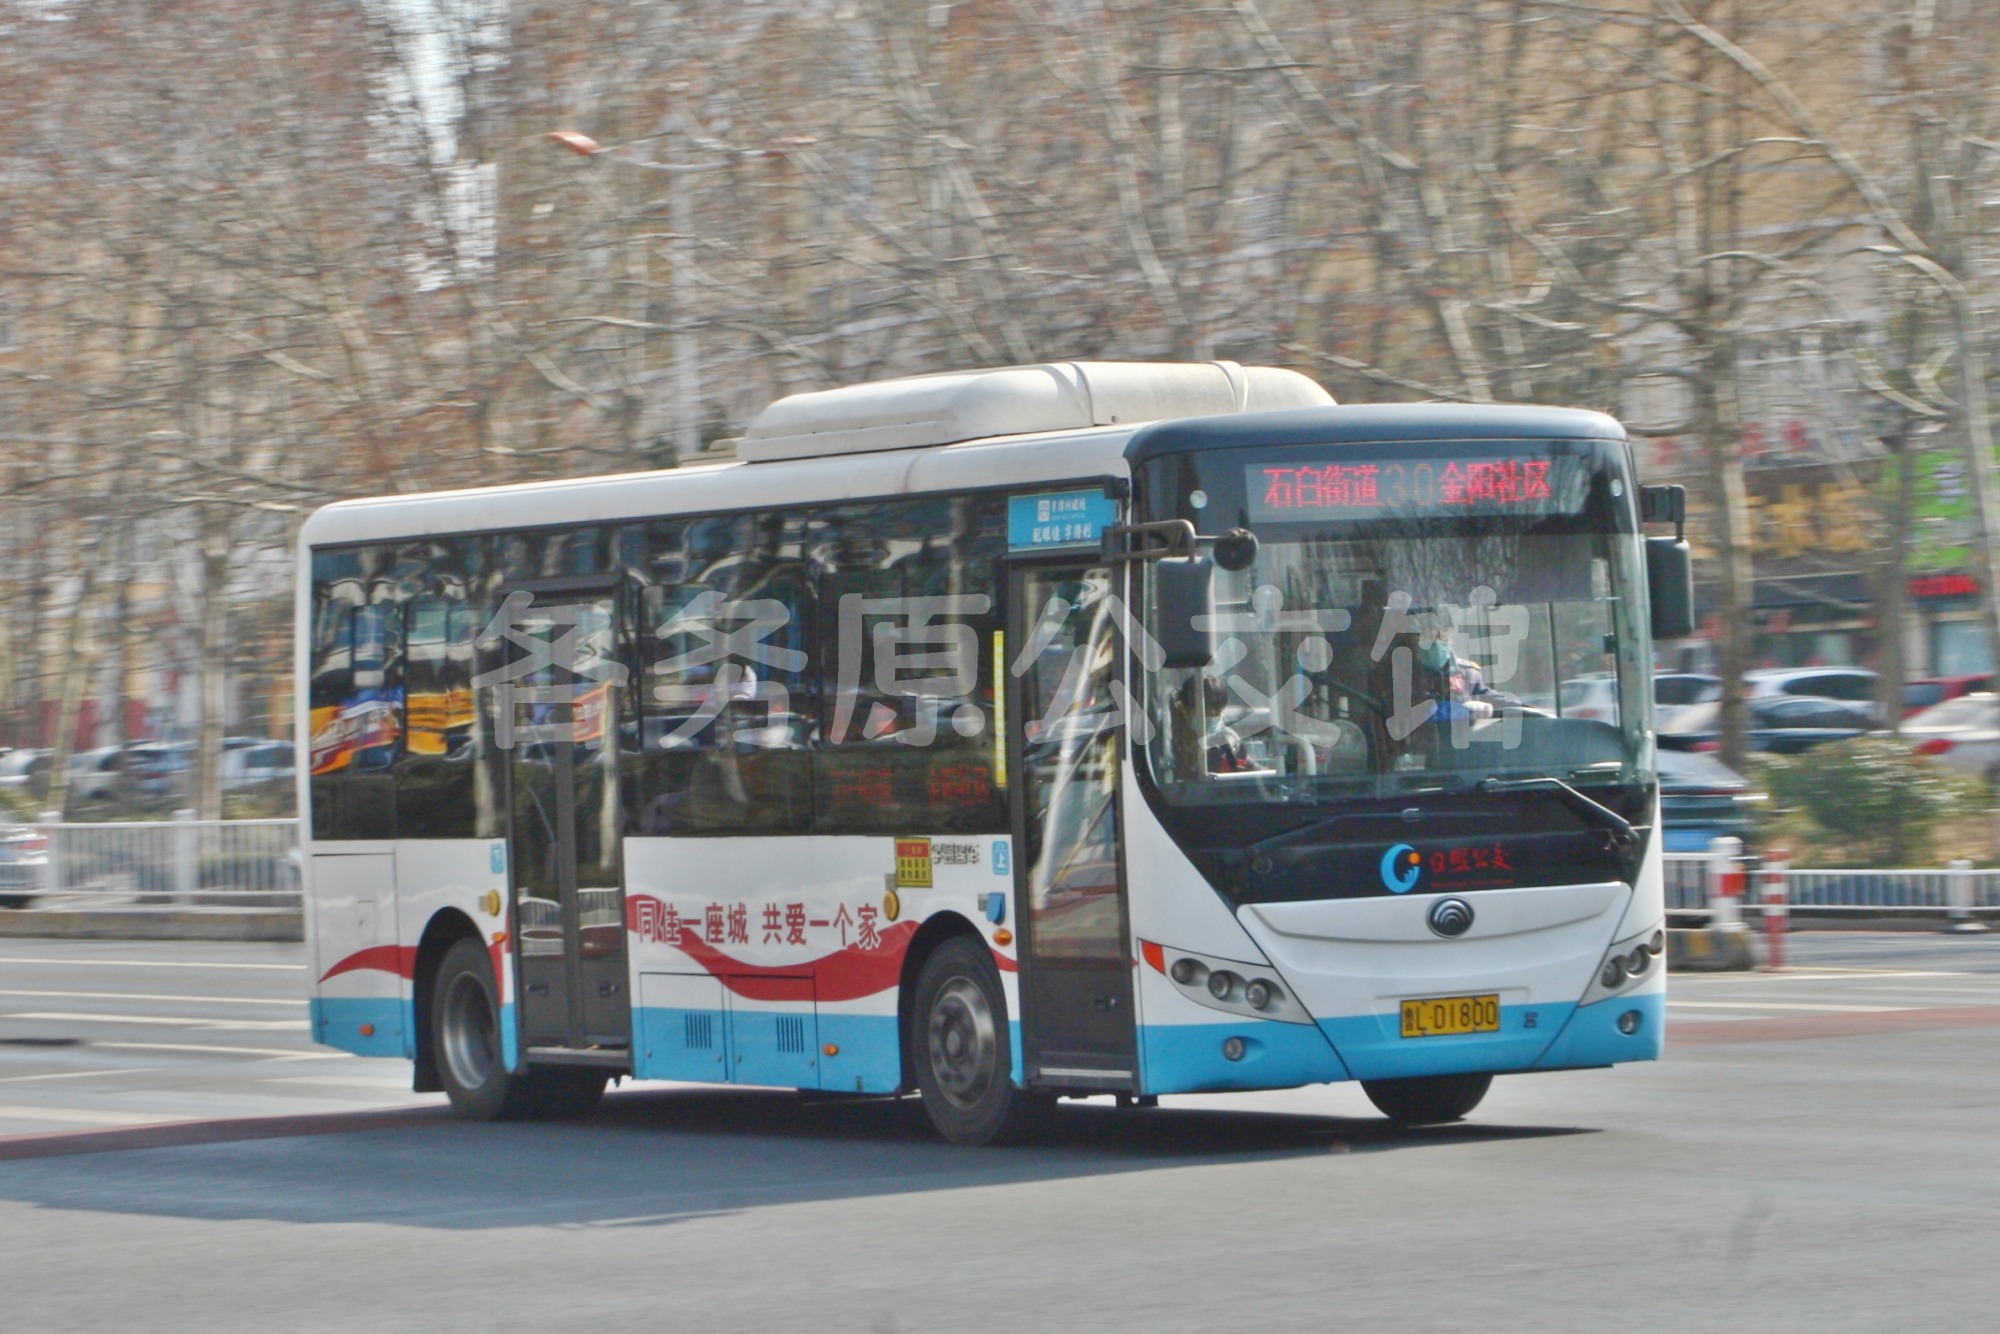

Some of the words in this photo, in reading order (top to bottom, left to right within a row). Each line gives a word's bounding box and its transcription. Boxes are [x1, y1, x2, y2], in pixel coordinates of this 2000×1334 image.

[1384, 462, 1434, 508] 30
[636, 899, 751, 946] 同住一座城
[761, 901, 882, 951] 共爱一个家
